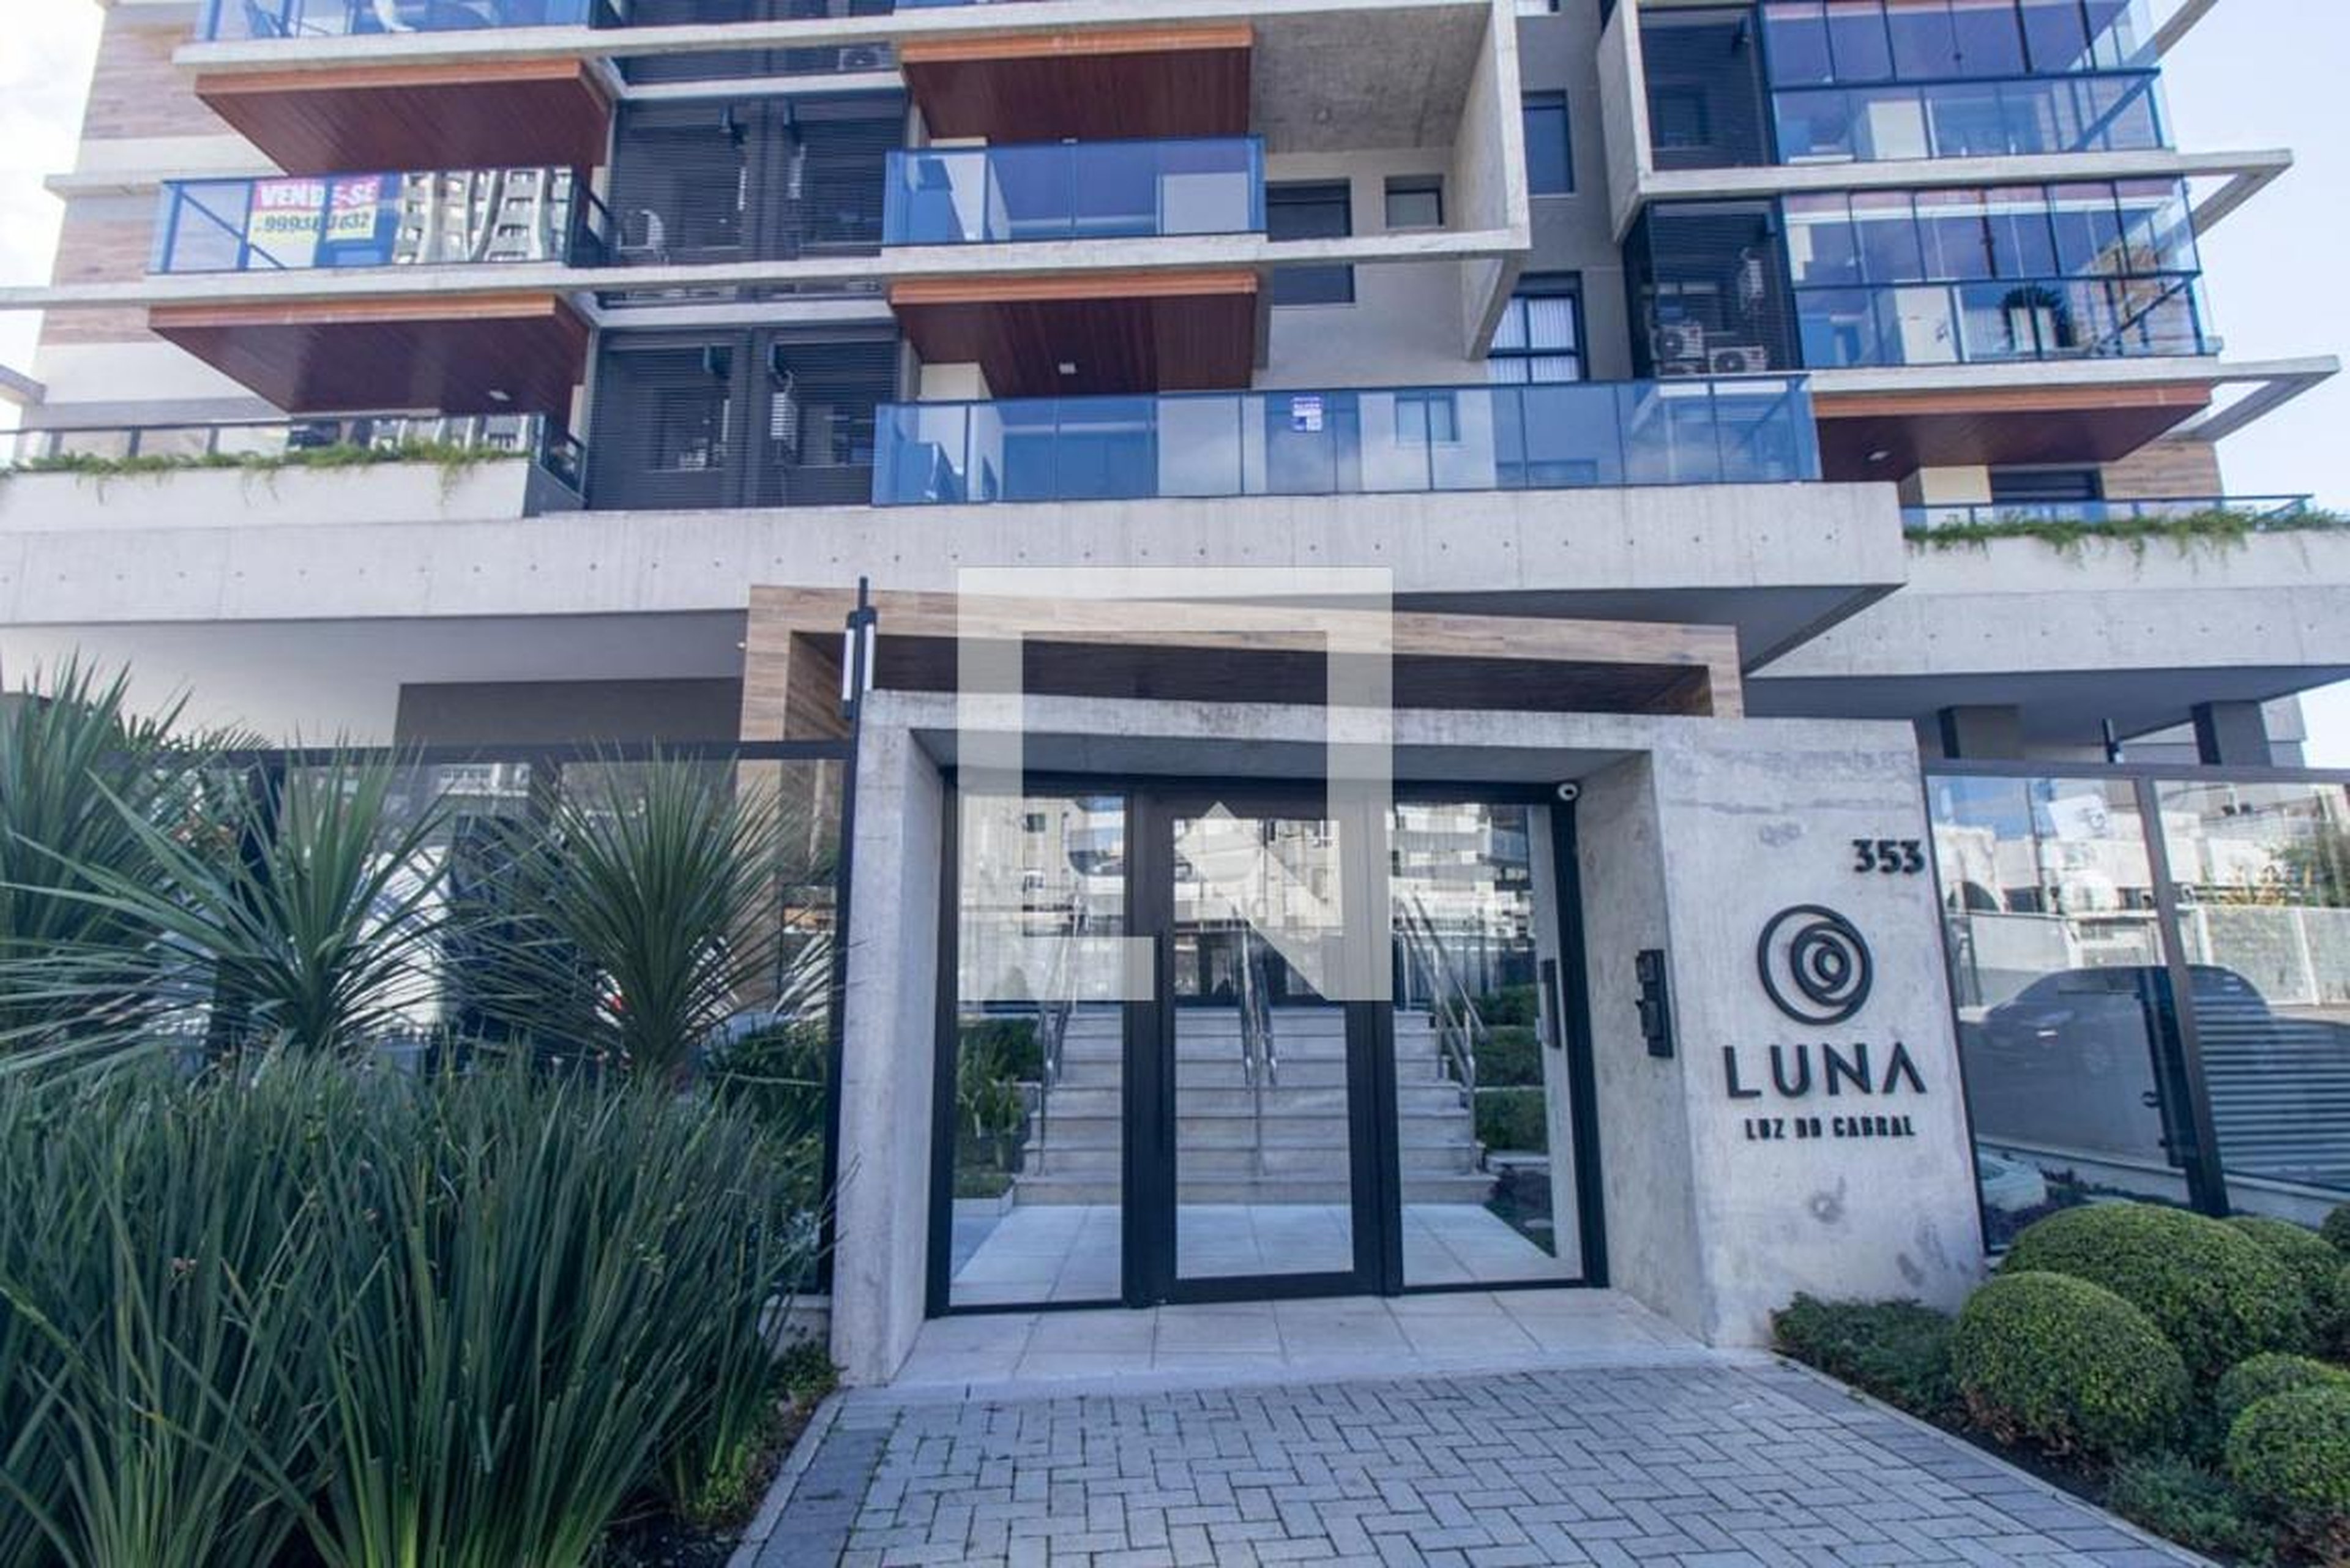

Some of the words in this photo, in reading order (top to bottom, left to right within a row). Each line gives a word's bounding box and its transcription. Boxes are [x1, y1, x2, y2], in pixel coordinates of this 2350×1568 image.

[1852, 840, 1925, 874] 353
[1724, 1042, 1927, 1099] LUNA
[1745, 1118, 1785, 1140] LUZ
[1795, 1118, 1822, 1139] DO
[1833, 1115, 1915, 1138] CABRAL
